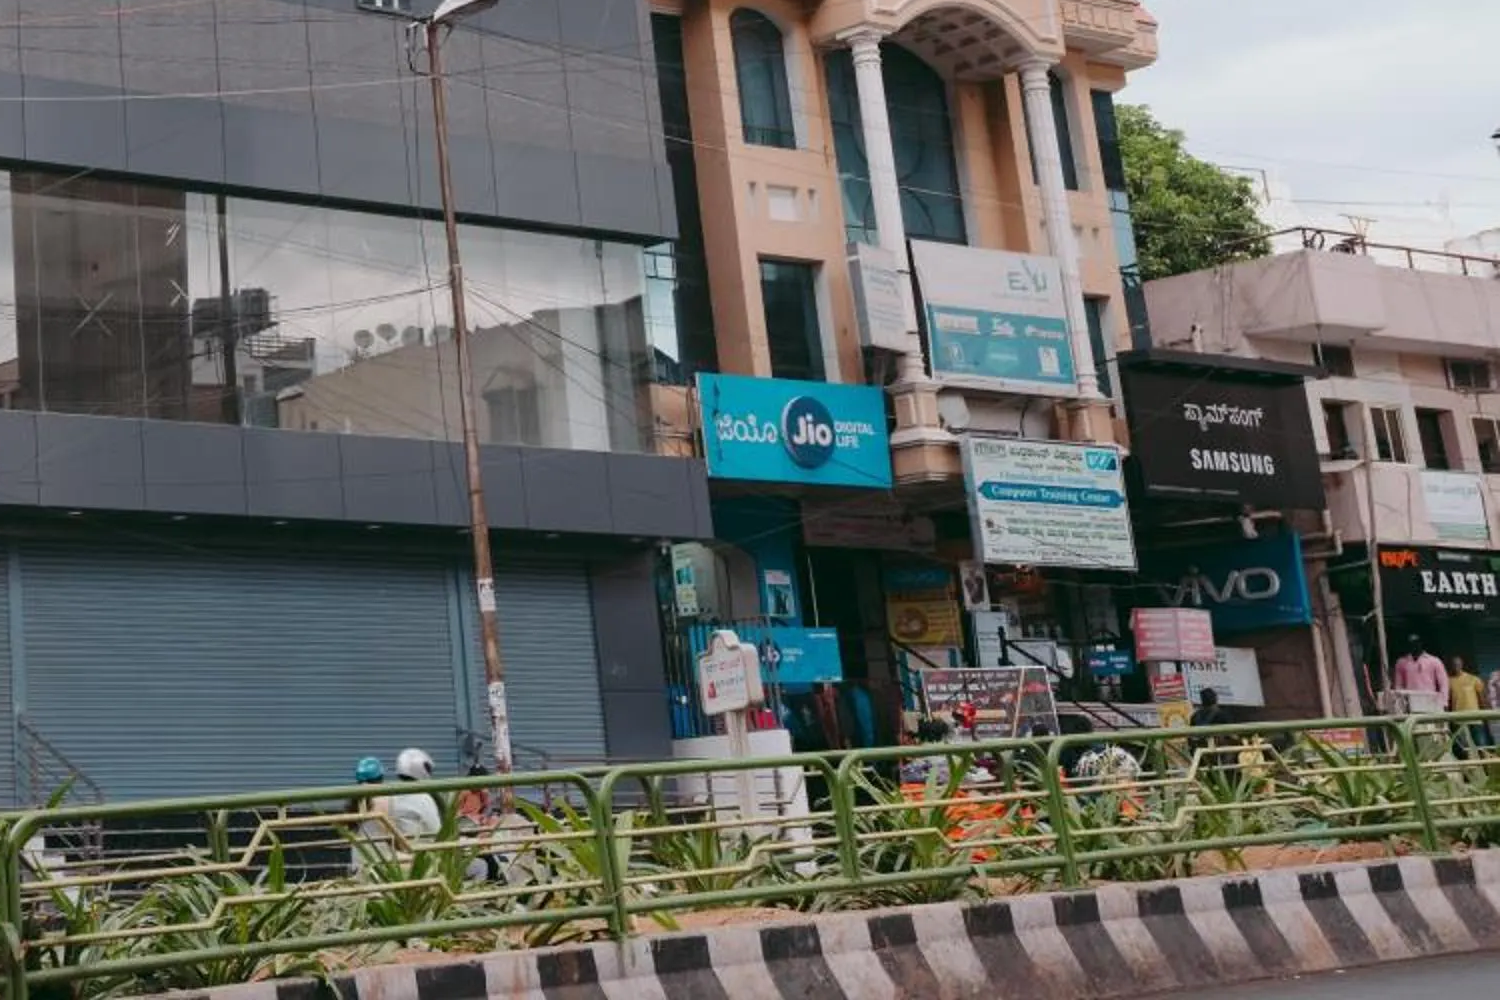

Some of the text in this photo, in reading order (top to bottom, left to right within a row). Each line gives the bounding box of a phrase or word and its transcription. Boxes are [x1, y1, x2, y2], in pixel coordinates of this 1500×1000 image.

[793, 413, 832, 447] Jio
[834, 420, 875, 435] DIGITAL
[835, 434, 860, 448] LIFE
[1189, 447, 1275, 476] SAMSUNG
[1420, 570, 1498, 597] EARTH
